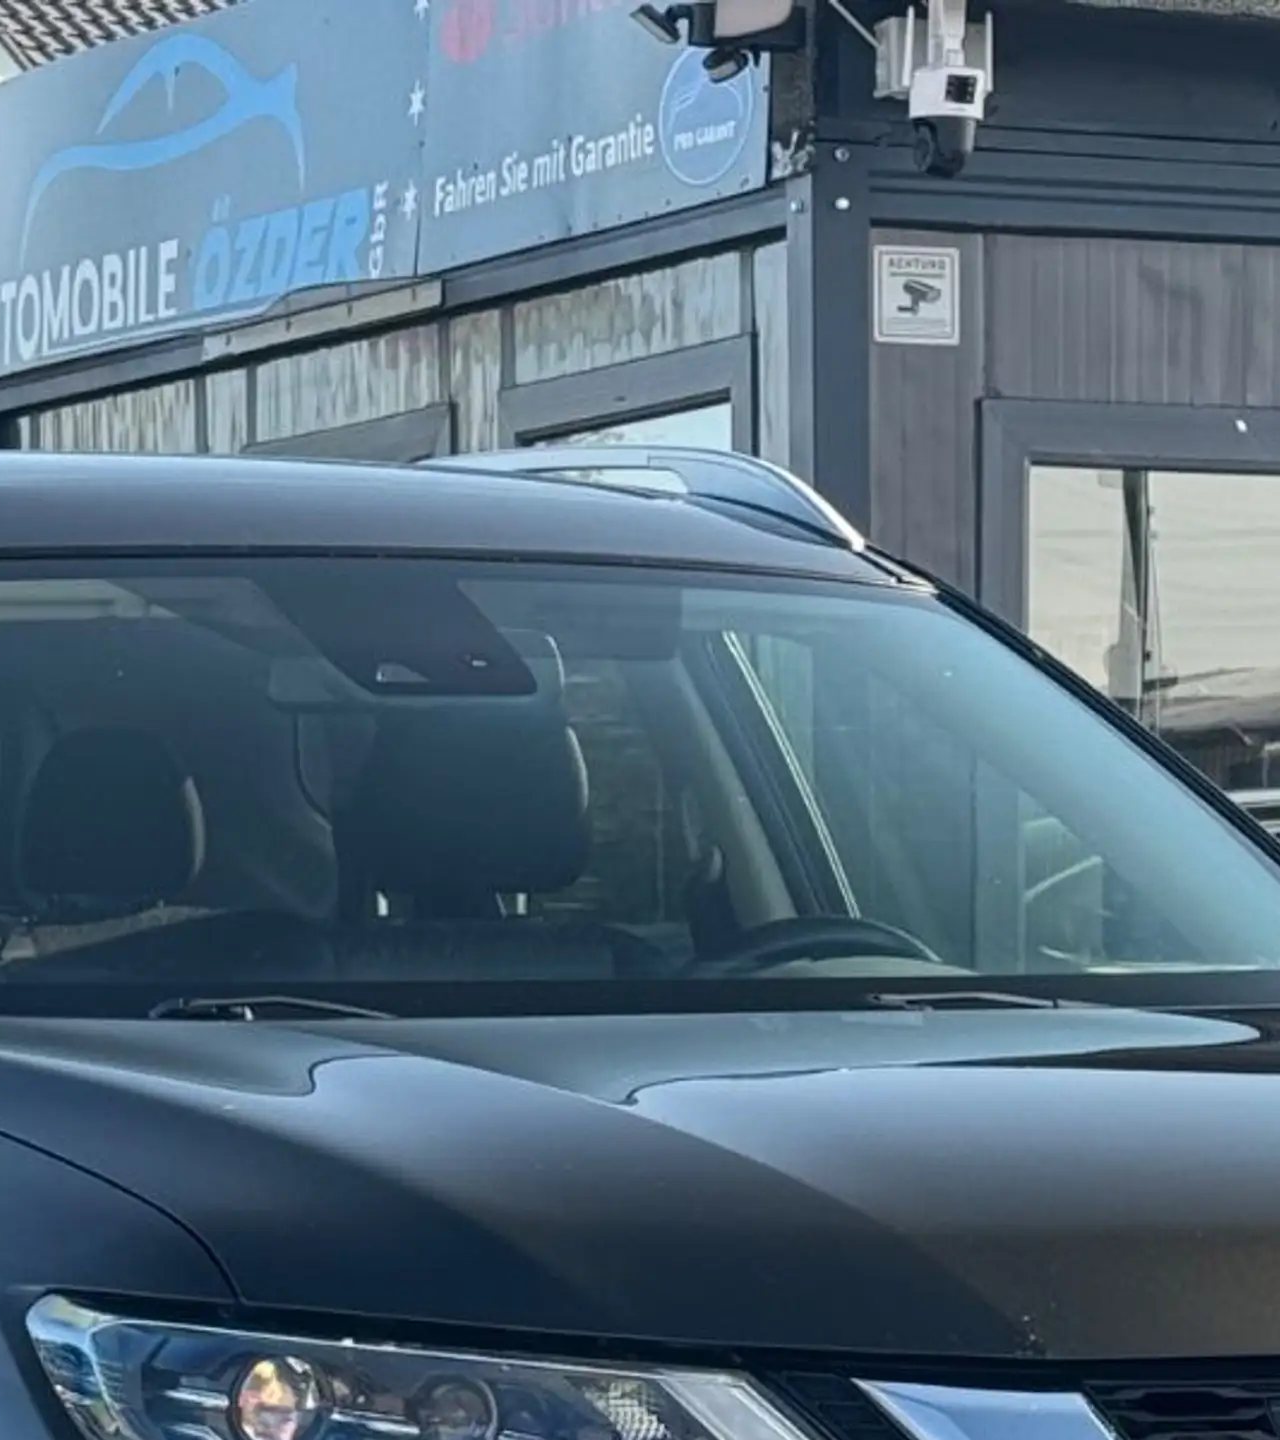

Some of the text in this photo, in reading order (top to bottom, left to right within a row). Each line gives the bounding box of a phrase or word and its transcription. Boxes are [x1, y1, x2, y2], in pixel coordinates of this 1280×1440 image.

[433, 112, 655, 218] Fahren Sie mit Garantie
[190, 186, 370, 312] ÖZDER
